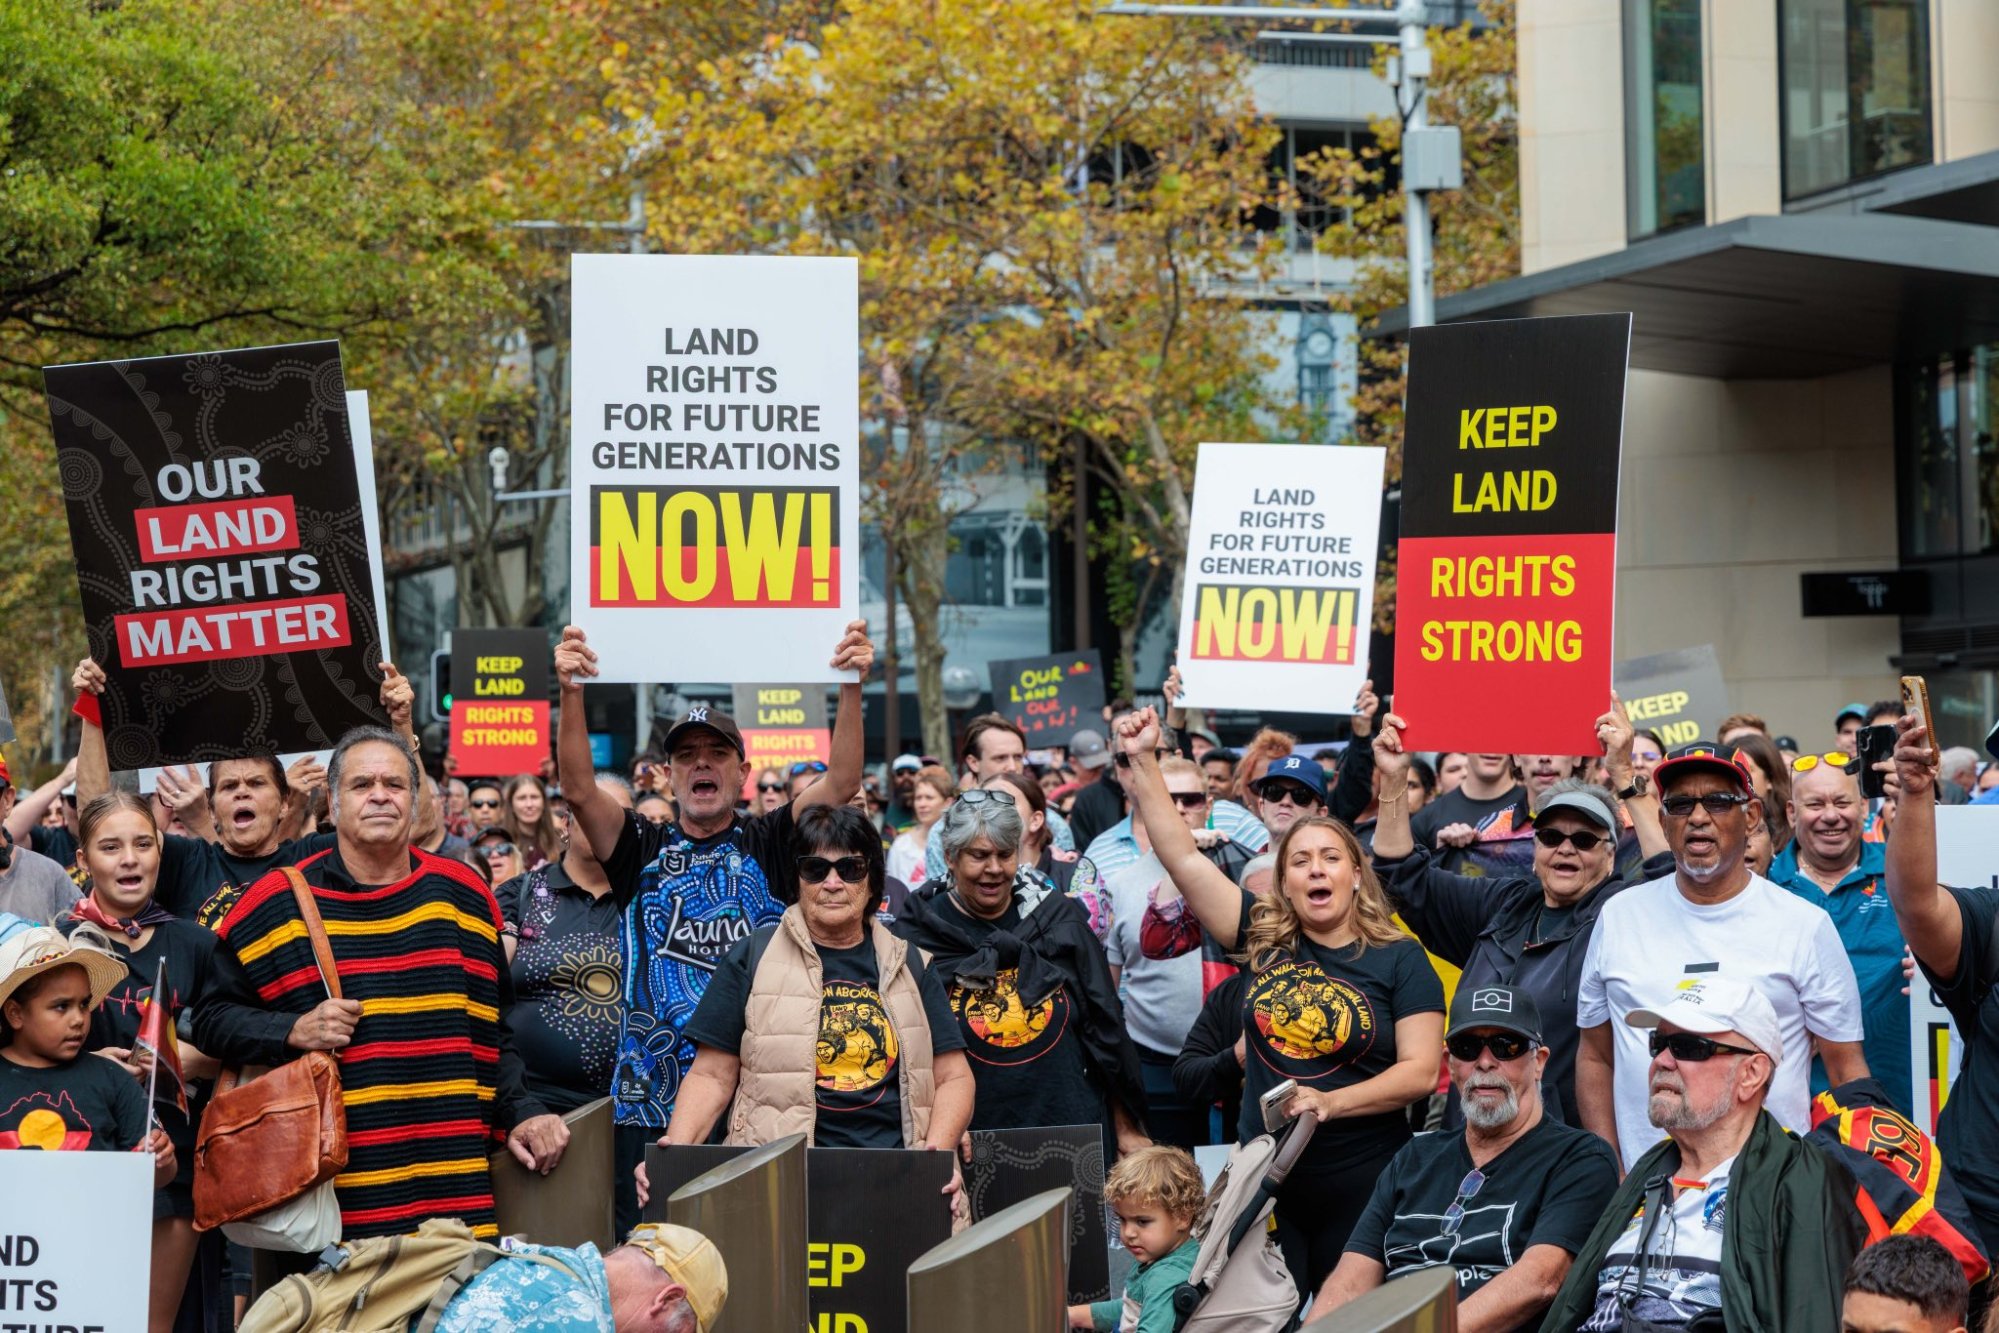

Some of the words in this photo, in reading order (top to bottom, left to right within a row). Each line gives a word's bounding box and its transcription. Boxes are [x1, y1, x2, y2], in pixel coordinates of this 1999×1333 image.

[664, 327, 759, 356] LAND
[646, 365, 778, 394] RIGHTS
[603, 403, 673, 432] FOR
[683, 404, 821, 433] FUTURE
[1459, 405, 1558, 450] KEEP
[591, 440, 841, 471] GENERATIONS
[157, 456, 265, 502] OUR
[1452, 469, 1558, 514] LAND
[1253, 488, 1316, 507] LAND
[148, 507, 286, 555] LAND
[1239, 511, 1326, 530] RIGHTS
[599, 490, 831, 602] NOW!
[1209, 533, 1255, 551] FOR
[1261, 534, 1352, 555] FUTURE
[130, 553, 321, 608] RIGHTS
[1199, 556, 1363, 579] GENERATIONS
[1430, 554, 1577, 598] RIGHTS
[126, 603, 341, 659] MATTER
[1196, 586, 1356, 662] NOW!
[1420, 619, 1583, 663] STRONG
[476, 656, 523, 674] KEEP
[1020, 665, 1064, 689] OUR
[475, 678, 525, 696] LAND
[758, 689, 802, 706] KEEP
[466, 706, 535, 724] RIGHTS
[758, 708, 805, 725] LAND
[1624, 690, 1690, 721] KEEP
[462, 728, 539, 746] STRONG
[751, 734, 816, 751] RIGHTS
[203, 902, 218, 916] ALL
[1257, 973, 1273, 987] ALL
[1271, 963, 1297, 977] WALK
[1298, 966, 1313, 978] ON
[1357, 1005, 1371, 1030] LAND
